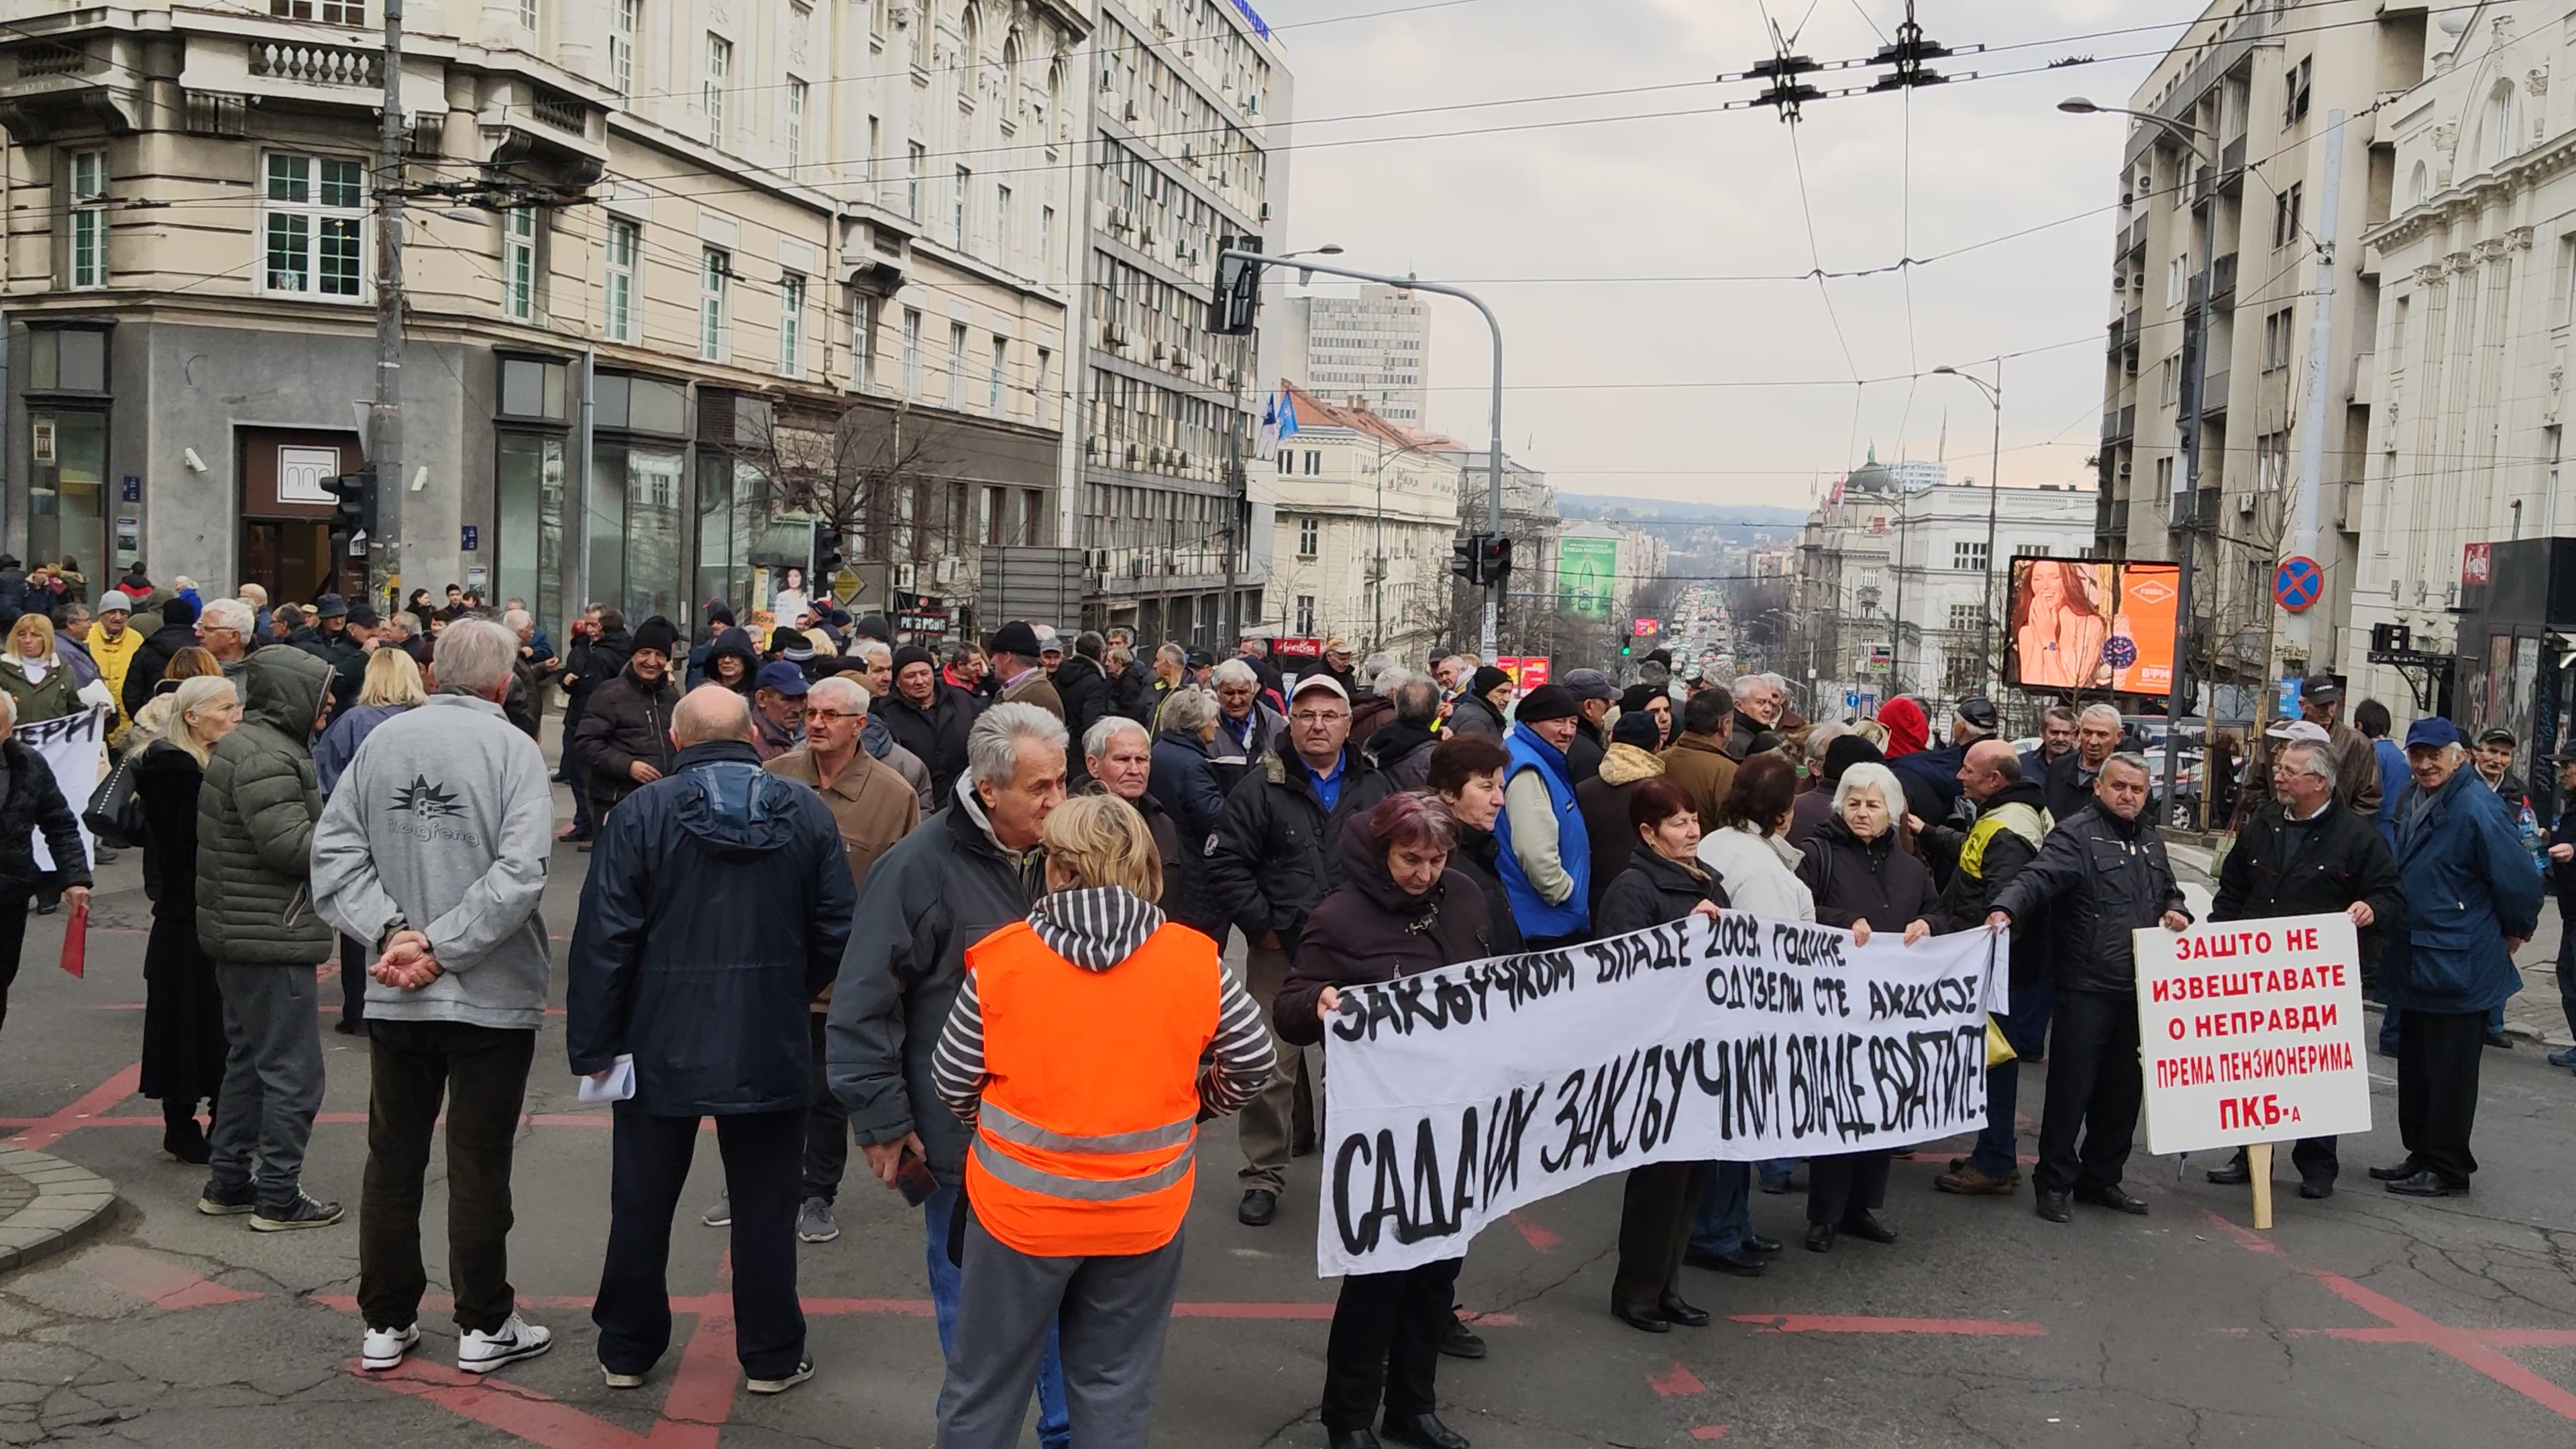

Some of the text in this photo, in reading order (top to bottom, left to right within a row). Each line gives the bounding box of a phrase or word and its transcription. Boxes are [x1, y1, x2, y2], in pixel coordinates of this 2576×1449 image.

[1585, 919, 1691, 984] ВЛАДЕ
[1705, 913, 1761, 959] 2009.
[1773, 923, 1847, 968] ГОДИНЕ
[2175, 928, 2319, 961] ЗАШТО НЕ
[1705, 964, 1804, 1014] ОДУЗЕЛИ
[1813, 976, 1851, 1018] СТЕ
[2152, 964, 2347, 1003] ИЗВЕШТАВАТЕ
[2168, 1004, 2337, 1040] О НЕПРАВДИ
[1786, 1031, 1876, 1145] ВЛАДЕ
[2156, 1041, 2354, 1089] ПРЕМА ПЕНЗИОНЕРИМА
